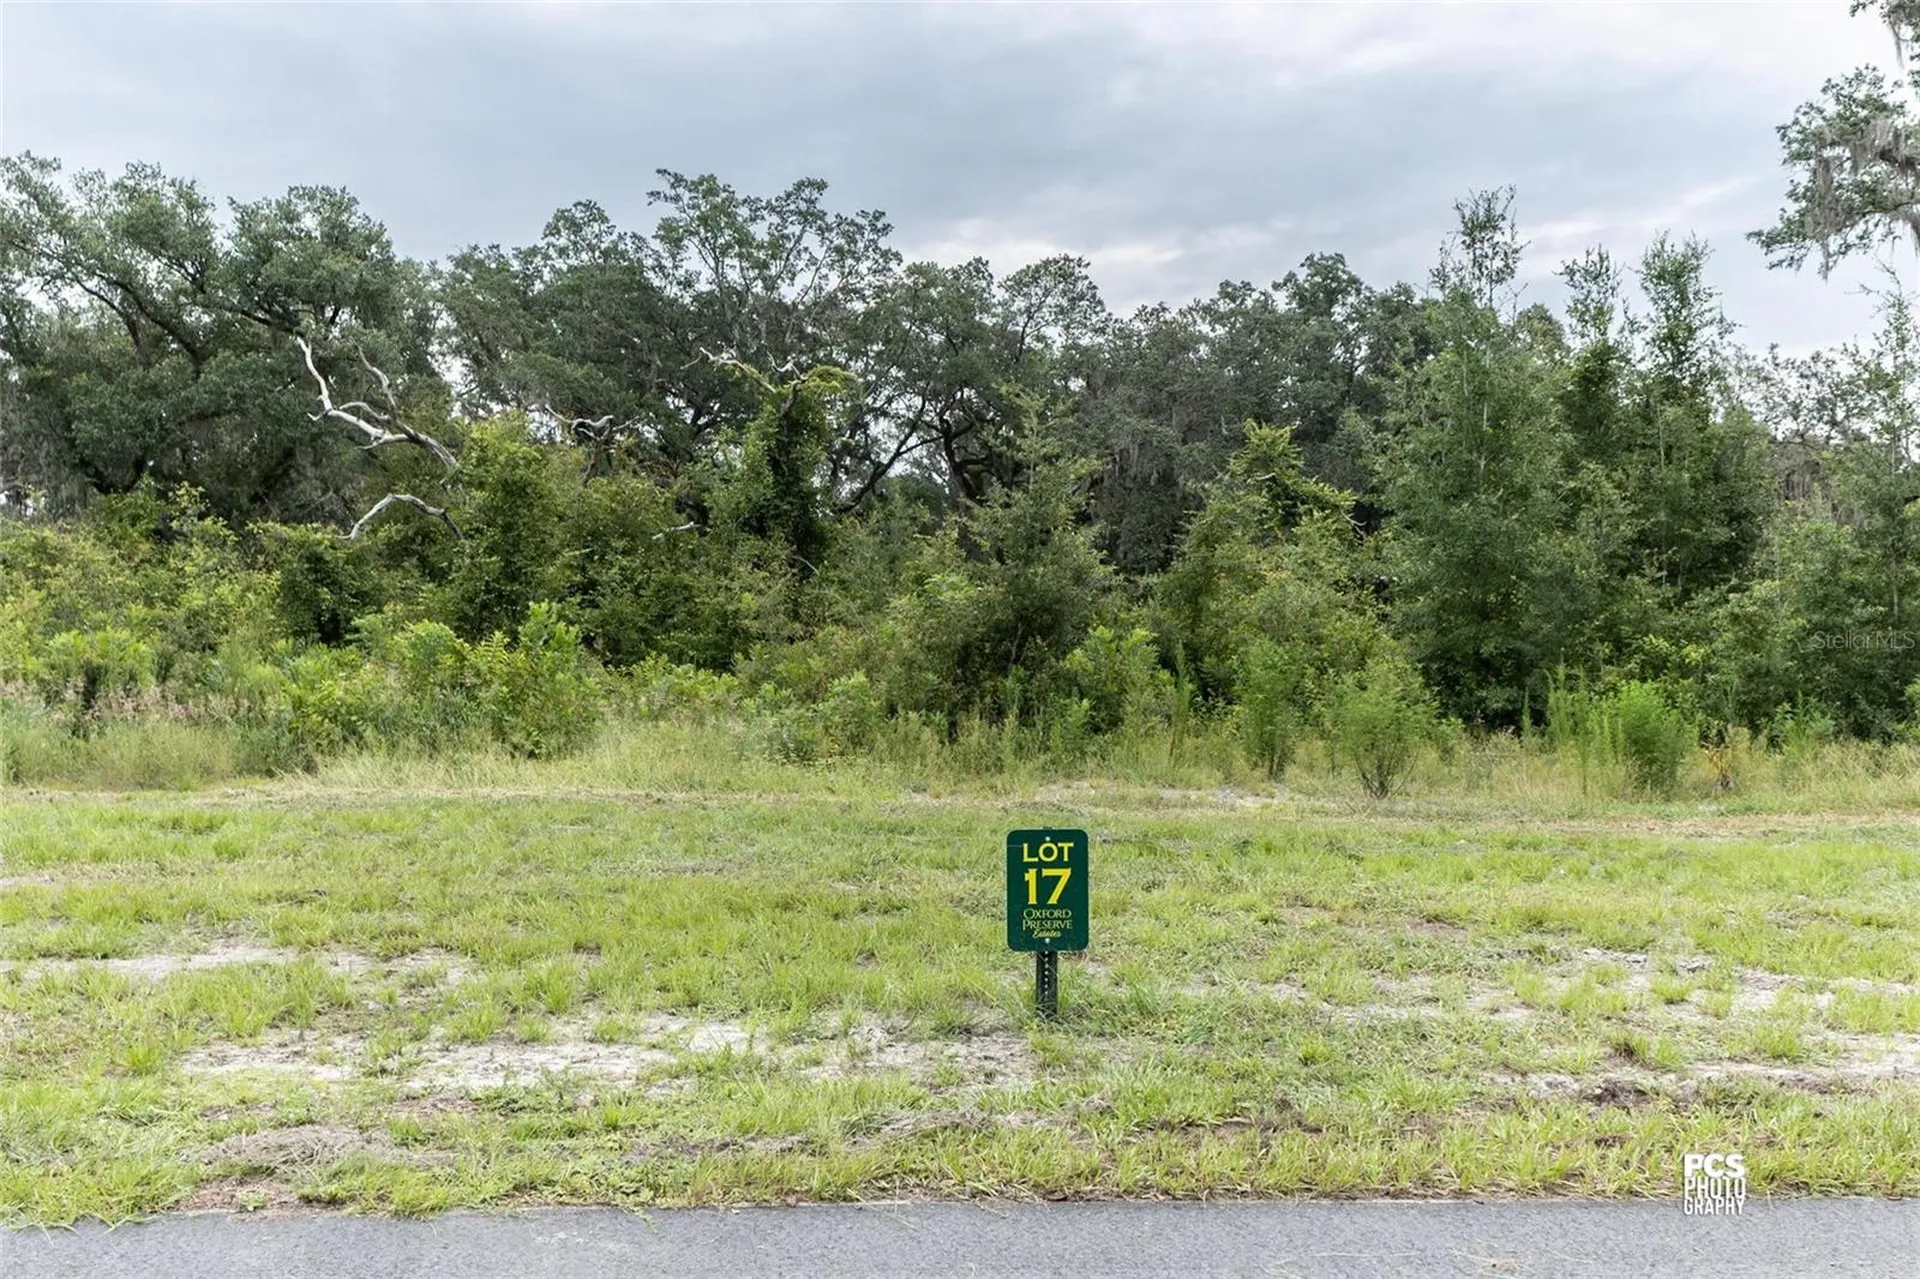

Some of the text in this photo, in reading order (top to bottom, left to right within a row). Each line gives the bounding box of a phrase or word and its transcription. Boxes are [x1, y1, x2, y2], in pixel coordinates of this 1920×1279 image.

[1022, 842, 1075, 863] LOT
[1024, 867, 1072, 905] 17
[1022, 907, 1073, 920] OXFORD
[1022, 919, 1073, 931] PRESERVE
